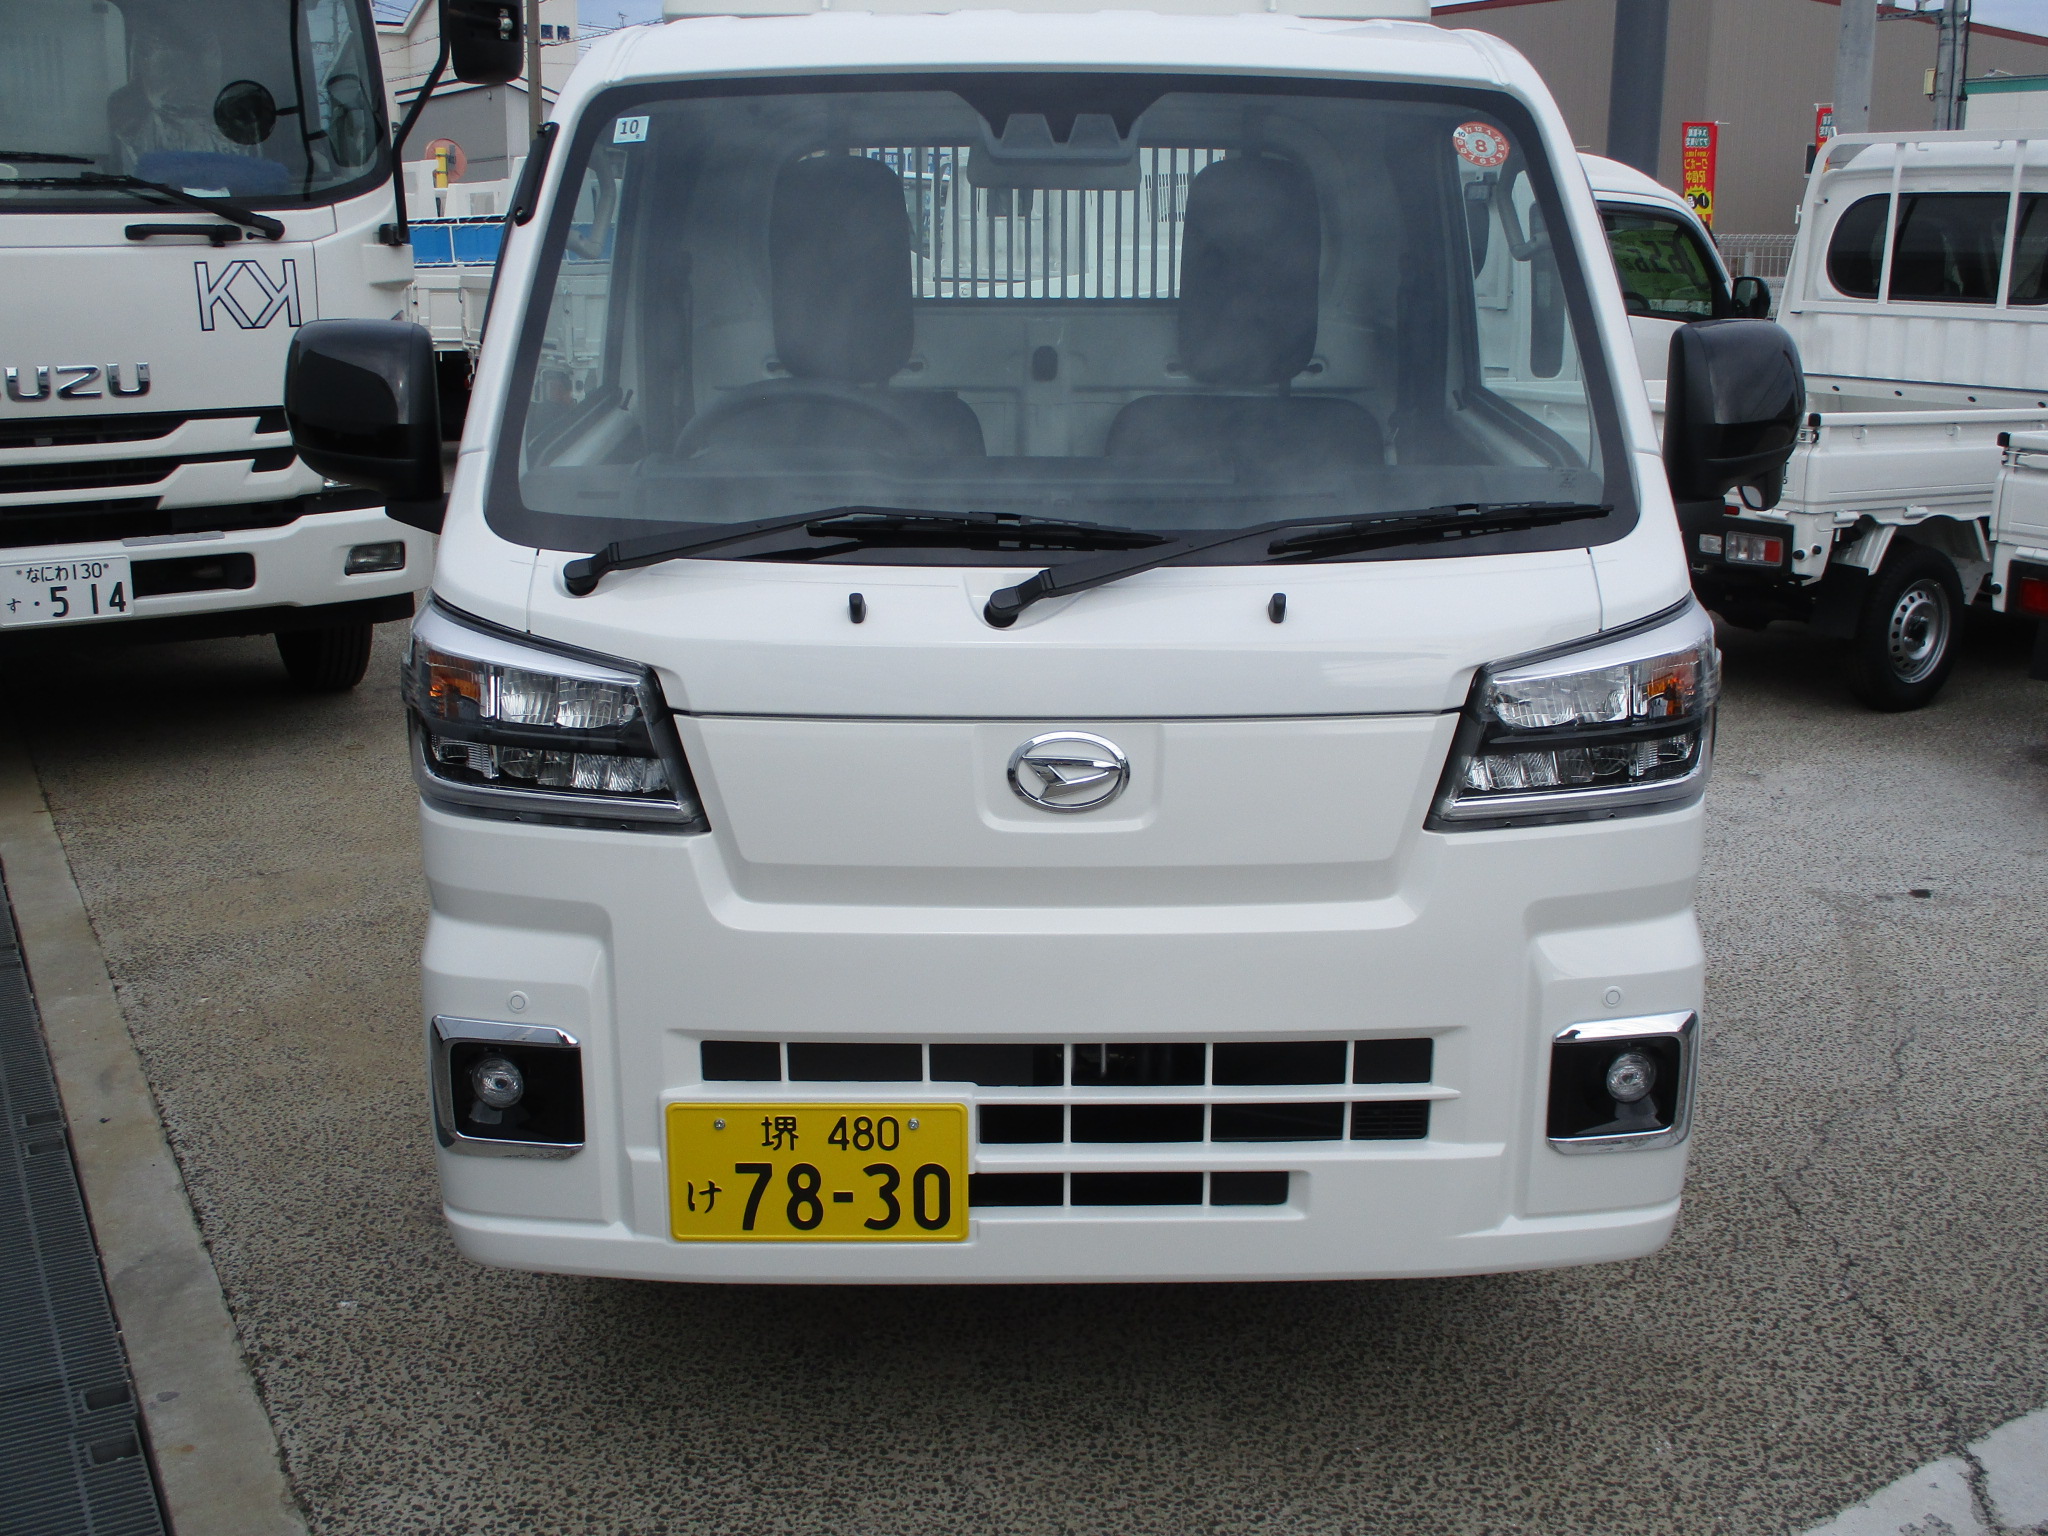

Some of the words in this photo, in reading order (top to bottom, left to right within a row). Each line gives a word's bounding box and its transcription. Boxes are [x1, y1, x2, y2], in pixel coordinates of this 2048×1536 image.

[619, 119, 639, 135] 10
[1475, 139, 1488, 153] 8
[0, 362, 151, 402] UZU
[6, 598, 22, 614] す
[761, 1115, 799, 1151] 堺
[827, 1116, 900, 1151] 480
[687, 1180, 723, 1214] け
[734, 1162, 952, 1231] 78-30
